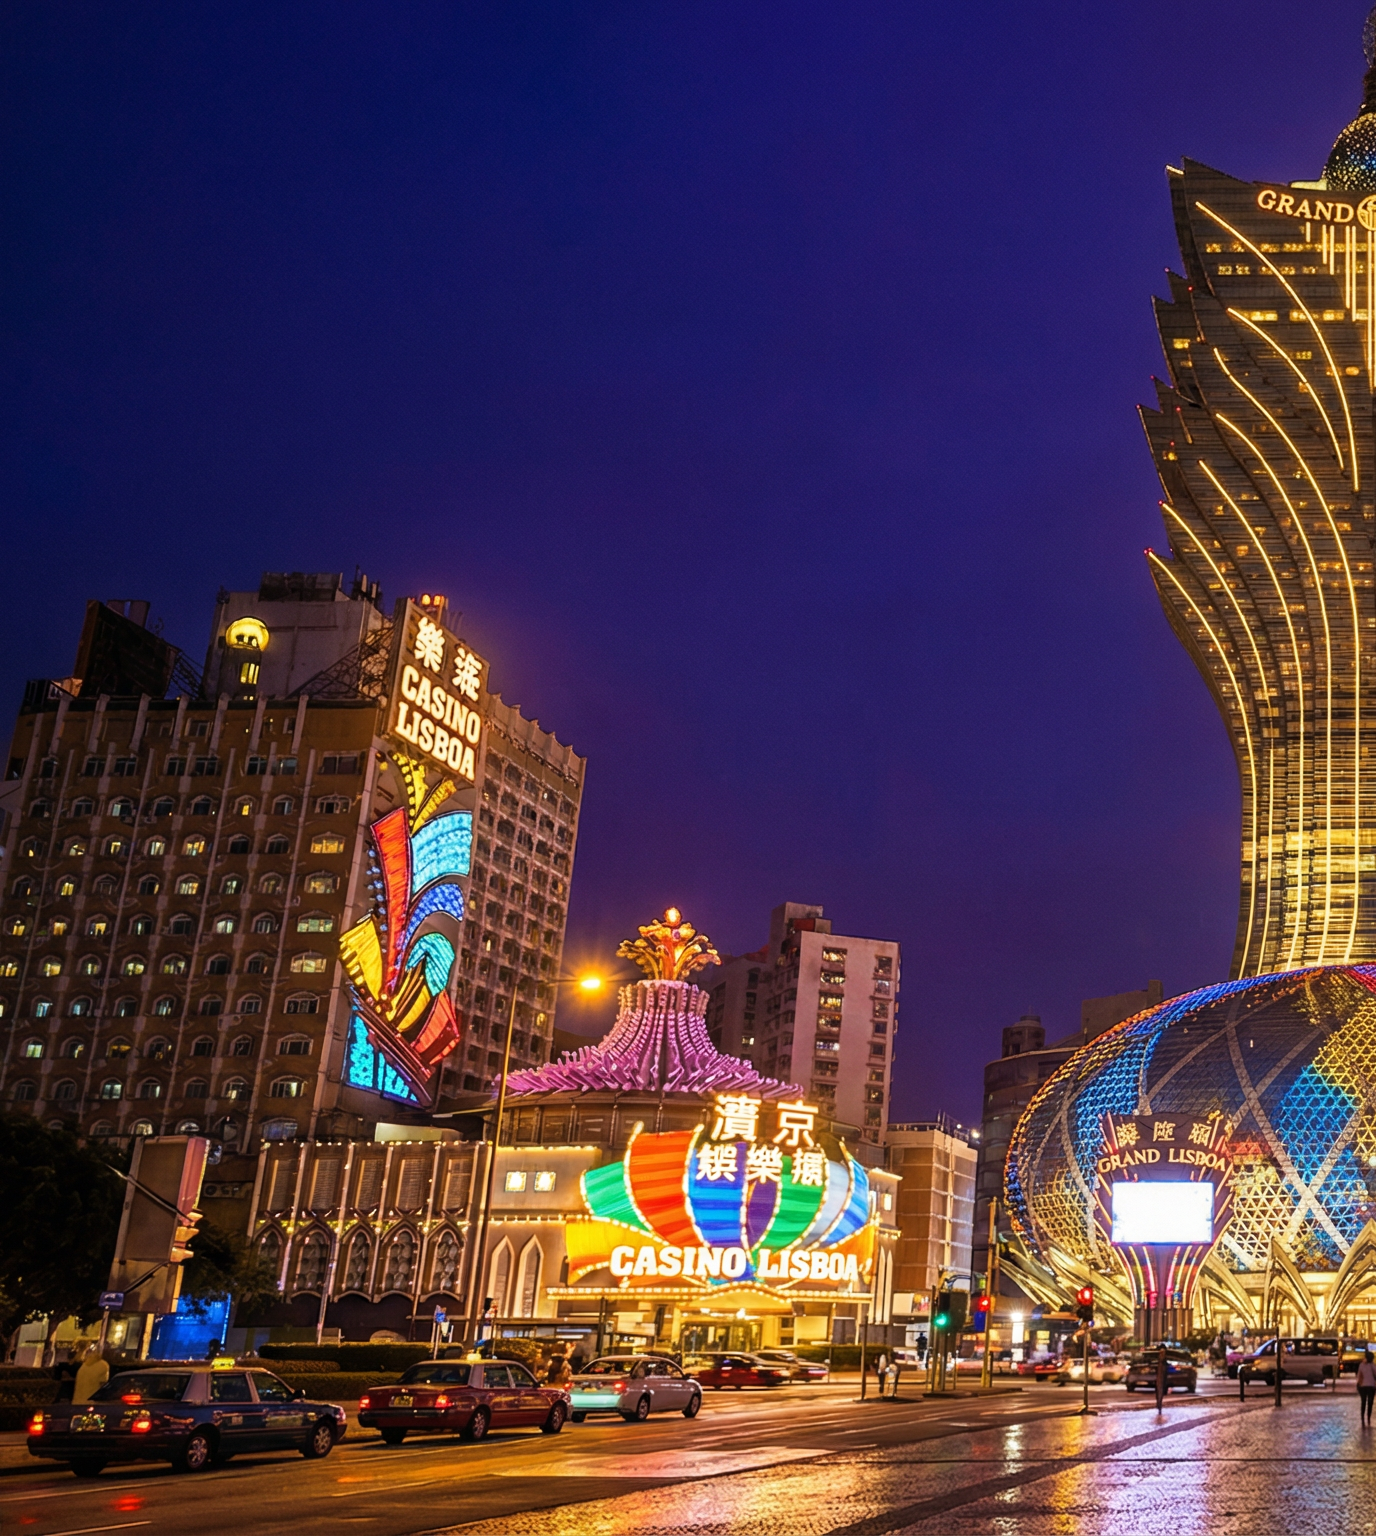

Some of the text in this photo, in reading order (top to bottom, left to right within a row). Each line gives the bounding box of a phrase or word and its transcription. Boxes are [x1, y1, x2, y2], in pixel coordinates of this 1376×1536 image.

[1257, 189, 1354, 223] GRAND
[401, 664, 482, 744] CASINO
[395, 701, 475, 781] LISBOA
[1098, 1148, 1161, 1174] GRAND
[609, 1245, 860, 1283] CASINO LISBOA
